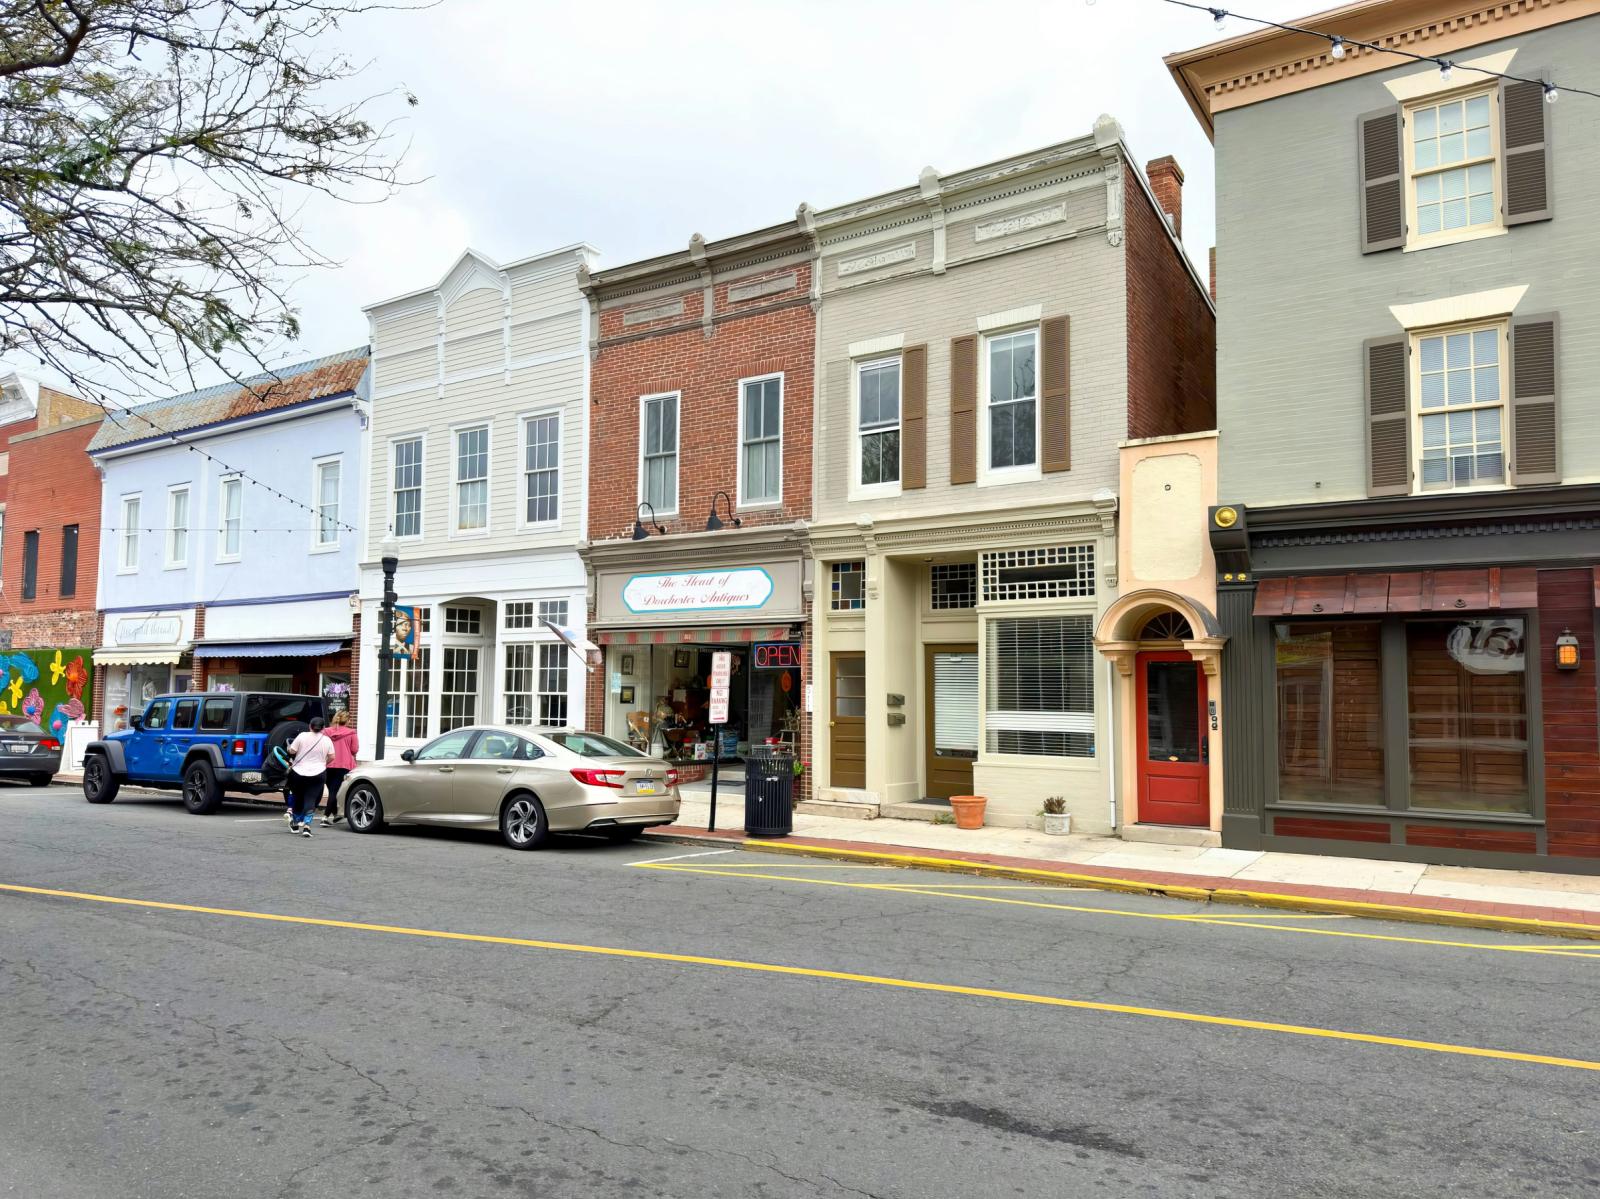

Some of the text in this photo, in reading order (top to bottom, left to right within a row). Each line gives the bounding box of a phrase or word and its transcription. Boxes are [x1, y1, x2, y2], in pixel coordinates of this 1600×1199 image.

[657, 573, 733, 588] The Heart of
[643, 591, 749, 606] Dorchester Antiques
[757, 645, 801, 666] OPEN
